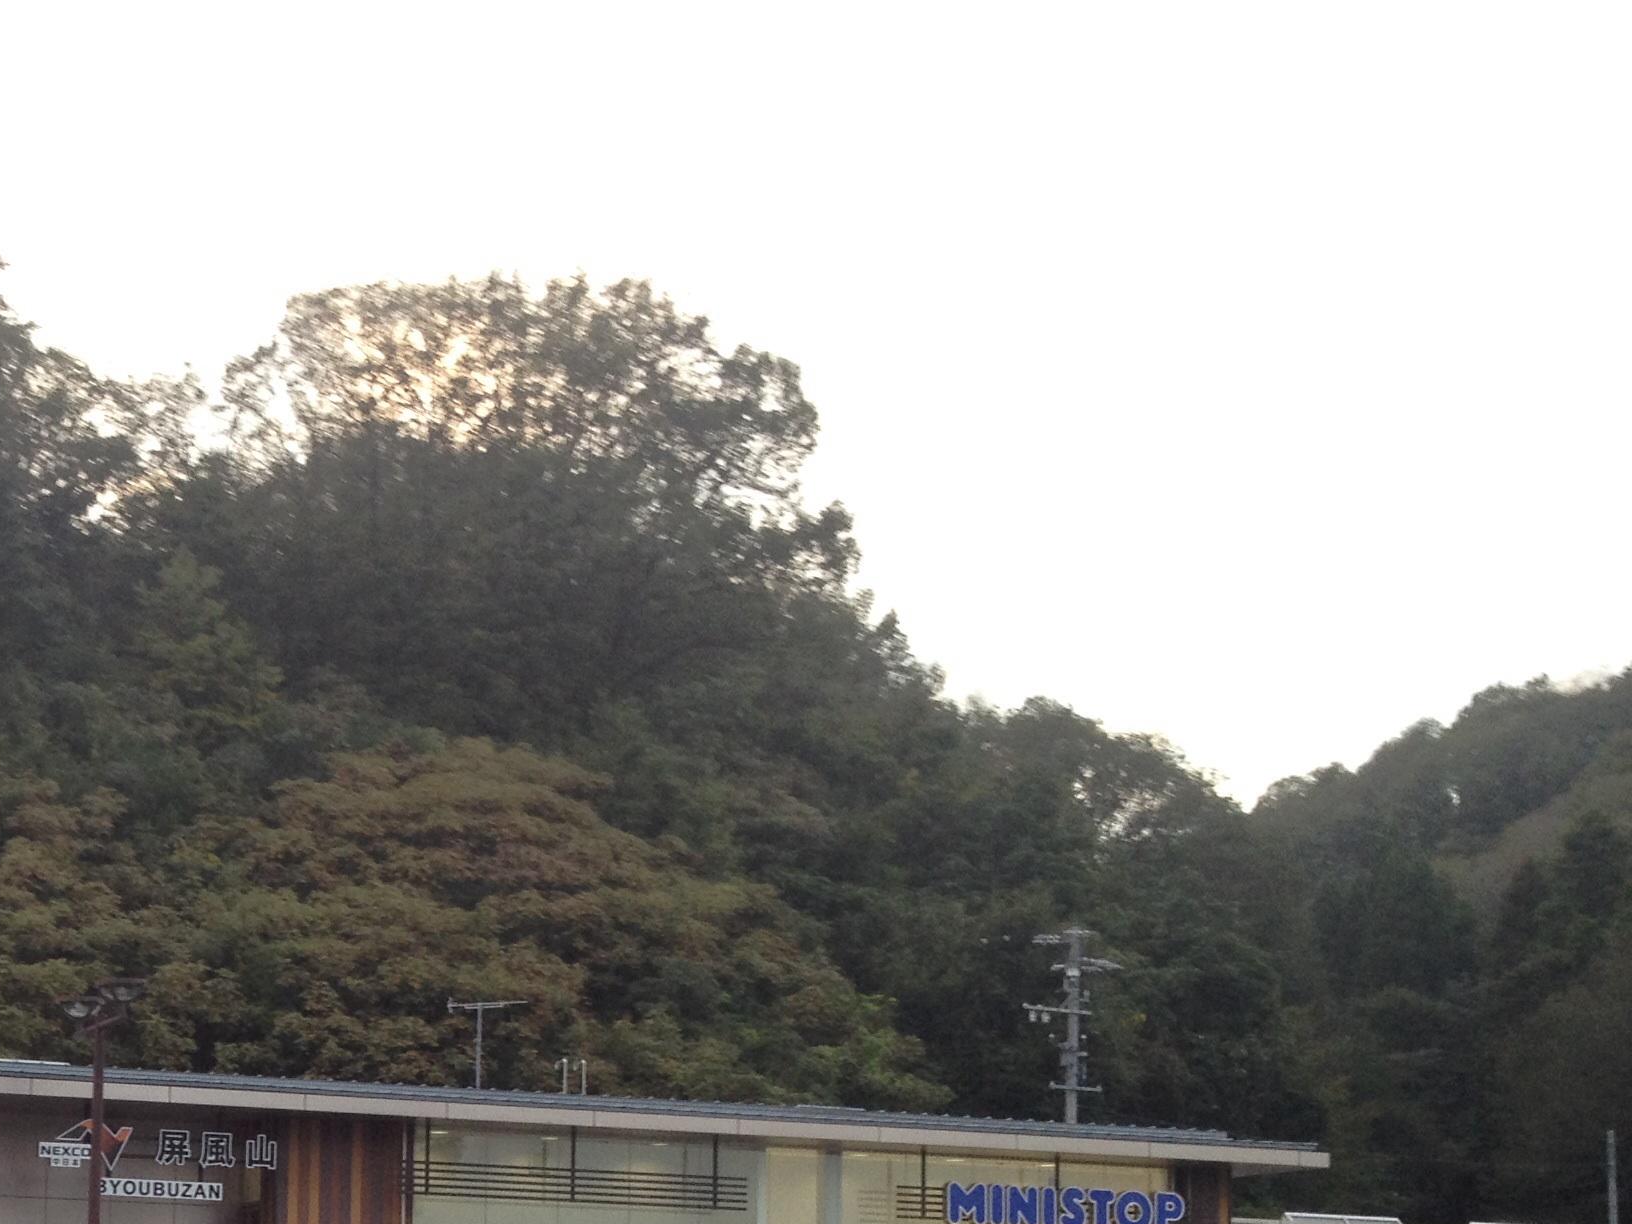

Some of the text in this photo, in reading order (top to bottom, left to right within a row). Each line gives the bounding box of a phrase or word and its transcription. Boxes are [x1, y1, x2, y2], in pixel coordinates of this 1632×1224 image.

[40, 1145, 92, 1157] NEXCO
[155, 1128, 278, 1170] 屏風山
